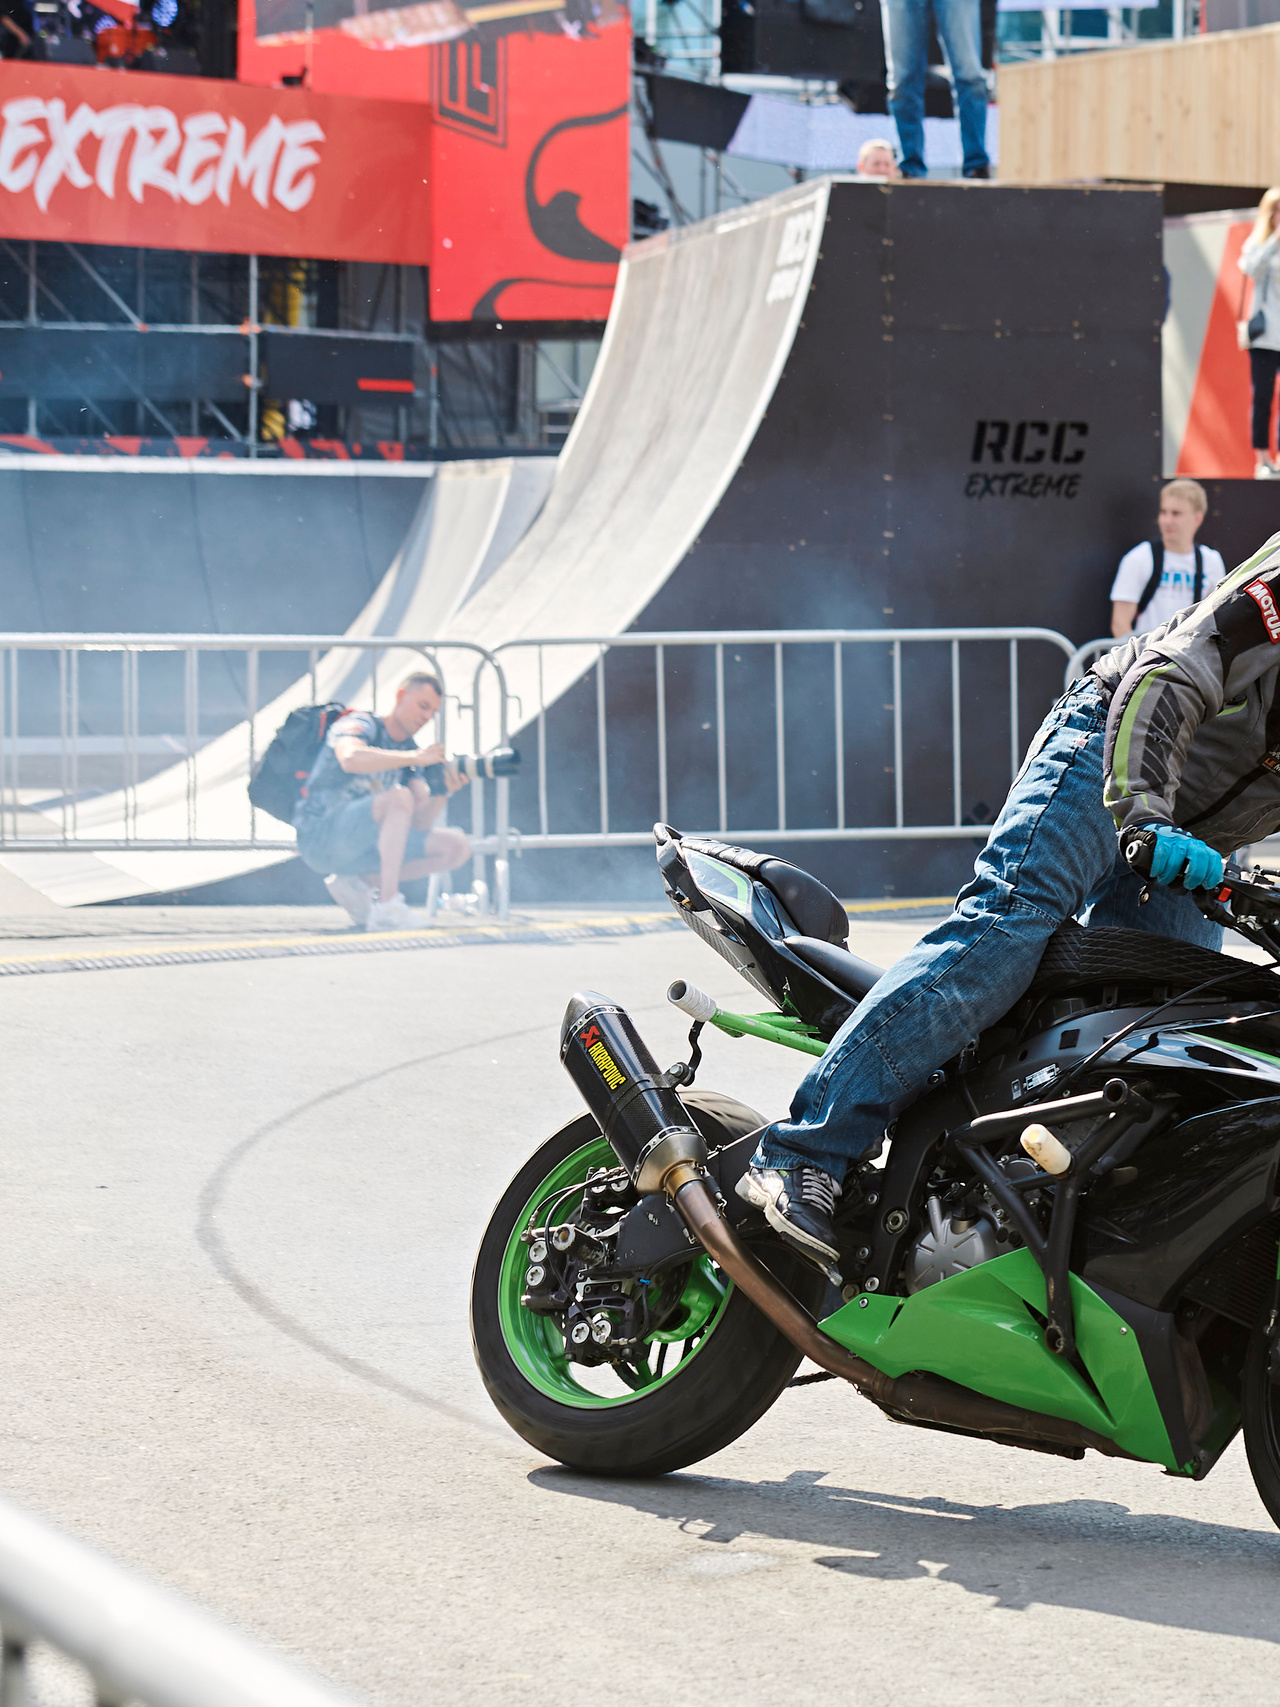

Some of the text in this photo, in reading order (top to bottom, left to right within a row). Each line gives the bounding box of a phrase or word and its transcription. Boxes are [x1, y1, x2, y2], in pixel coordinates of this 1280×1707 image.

[0, 97, 326, 212] EXTREME
[971, 420, 1089, 464] RCC
[965, 472, 1081, 500] EXTREME
[1264, 758, 1276, 770] LE
